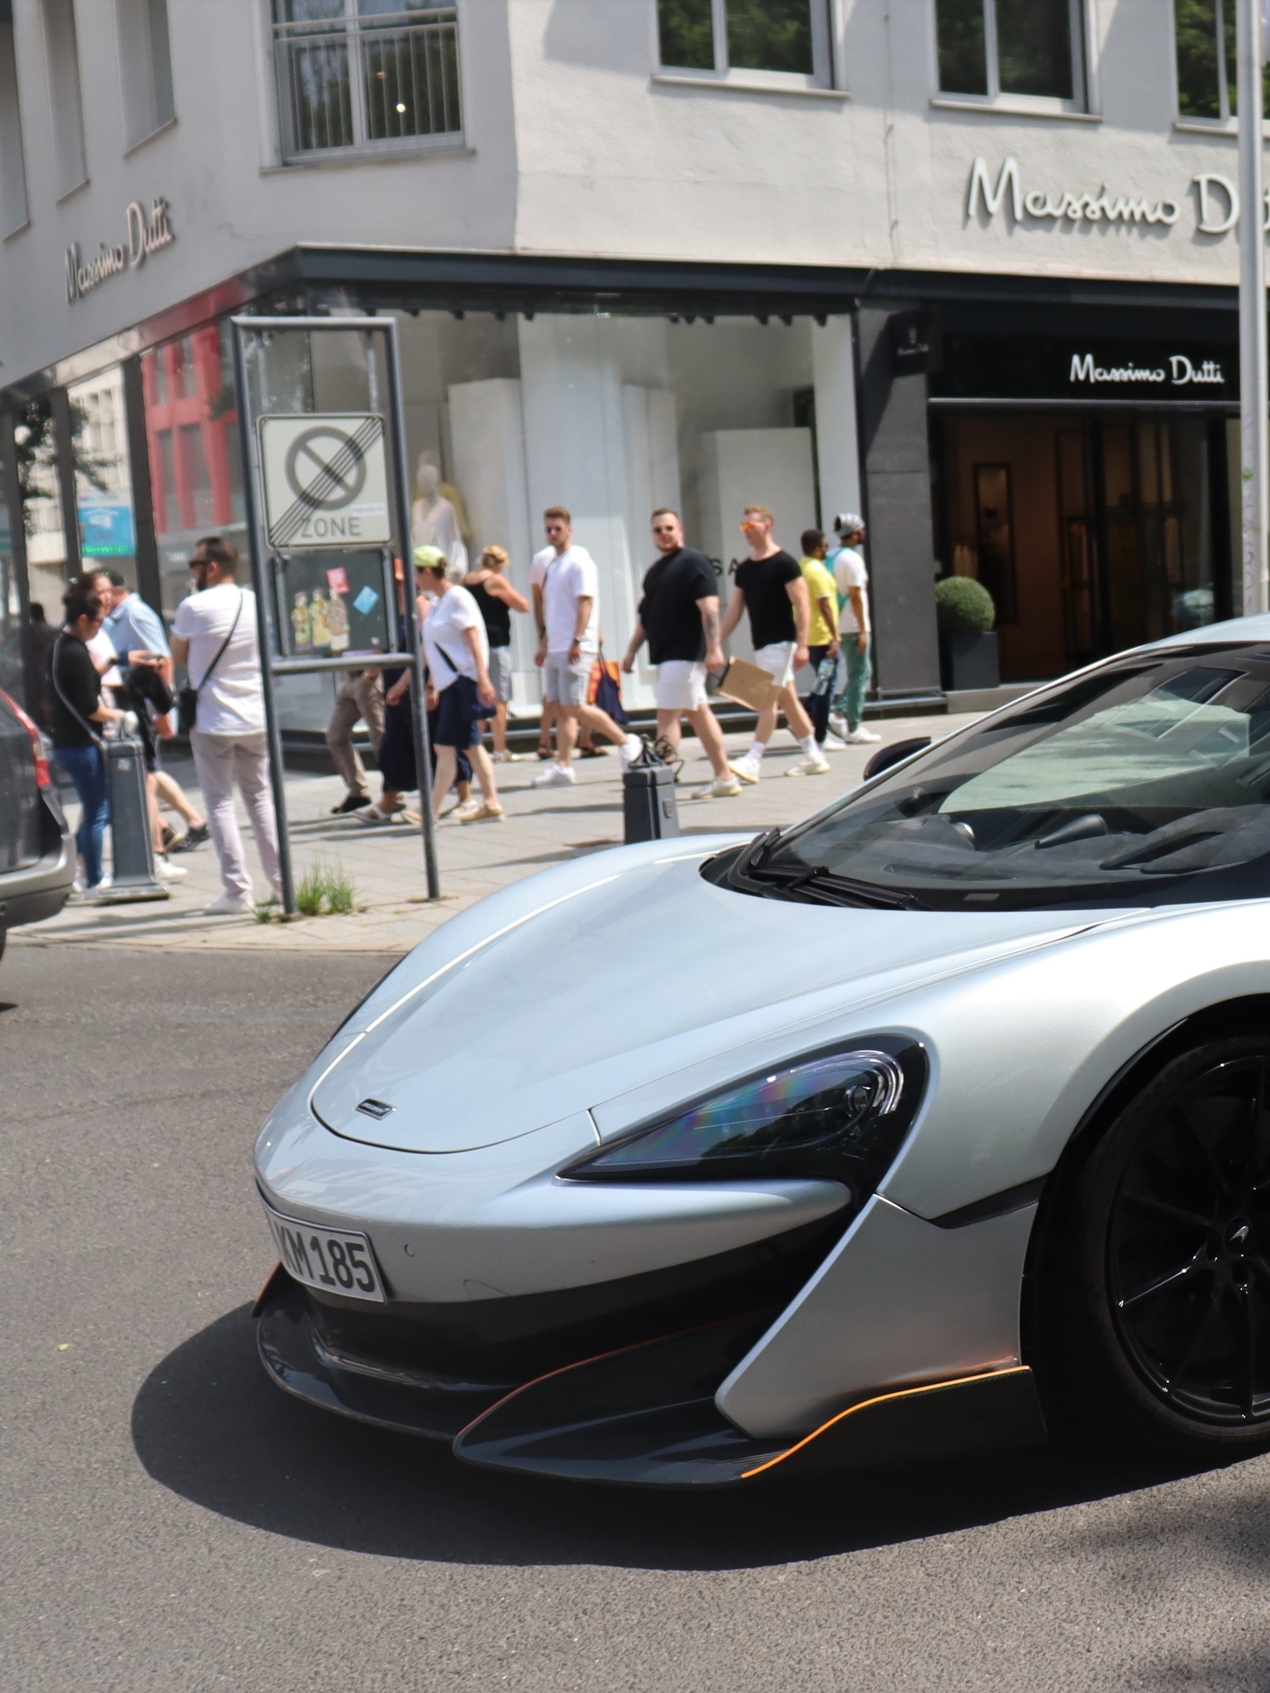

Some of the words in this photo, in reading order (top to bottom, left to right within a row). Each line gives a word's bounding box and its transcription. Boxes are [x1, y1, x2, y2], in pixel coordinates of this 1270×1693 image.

[968, 157, 1181, 224] Massimo
[65, 242, 124, 303] Massimo
[126, 197, 174, 268] Dutti
[1070, 353, 1166, 384] Massimo
[1169, 355, 1225, 385] Dutti
[301, 516, 361, 538] ZONE
